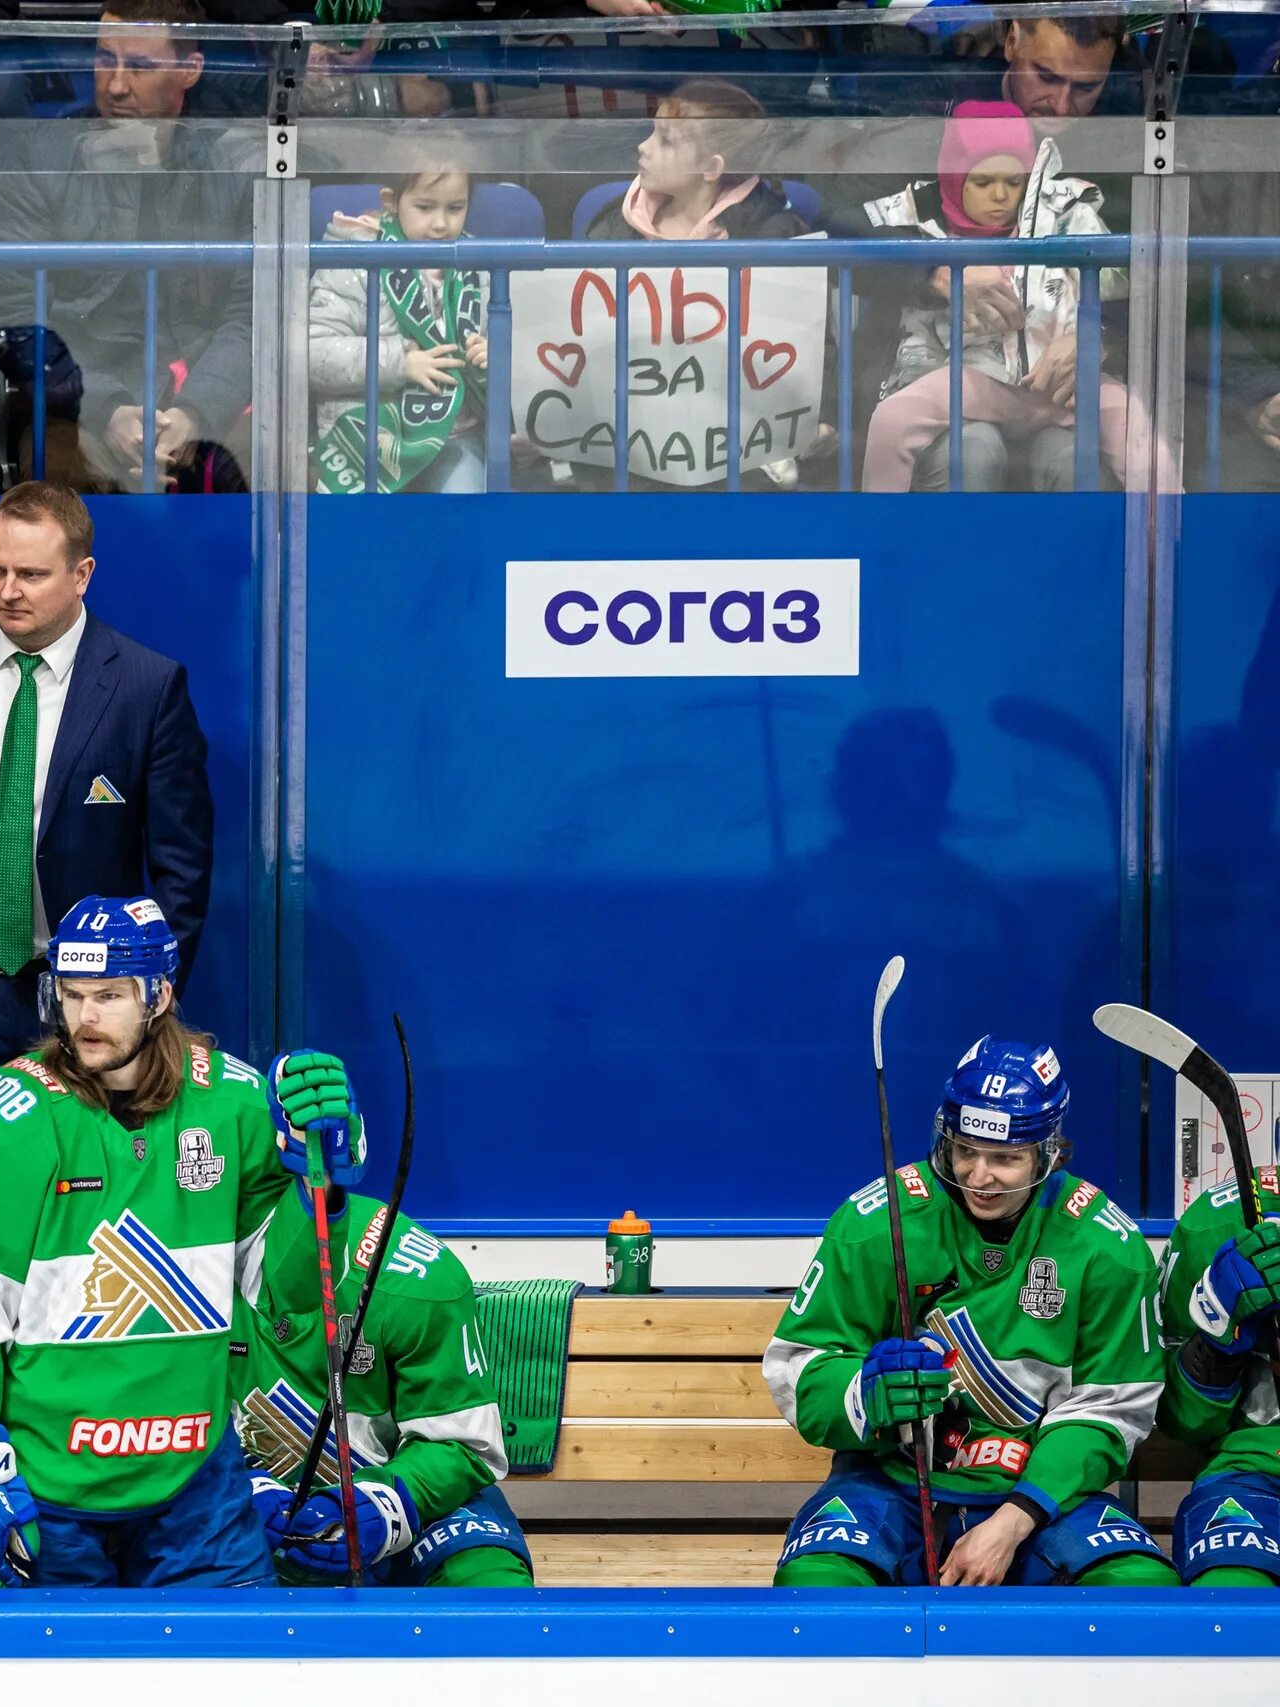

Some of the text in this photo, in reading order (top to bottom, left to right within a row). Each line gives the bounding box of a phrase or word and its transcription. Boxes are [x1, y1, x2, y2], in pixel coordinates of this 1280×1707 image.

[570, 267, 752, 345] МЫ
[615, 355, 705, 396] ЗА
[525, 389, 812, 472] САЛАВАТ
[544, 589, 821, 646] согаз
[77, 912, 109, 931] 10
[61, 951, 104, 963] согаз
[981, 1074, 1007, 1098] 19
[962, 1116, 1007, 1133] согаз
[628, 1246, 649, 1264] 98
[790, 1259, 824, 1315] 9
[462, 1315, 488, 1378] 41
[70, 1414, 210, 1454] FONBET
[782, 1526, 870, 1560] ПЕГАЗ
[1189, 1532, 1280, 1561] ПЕГАЗ
